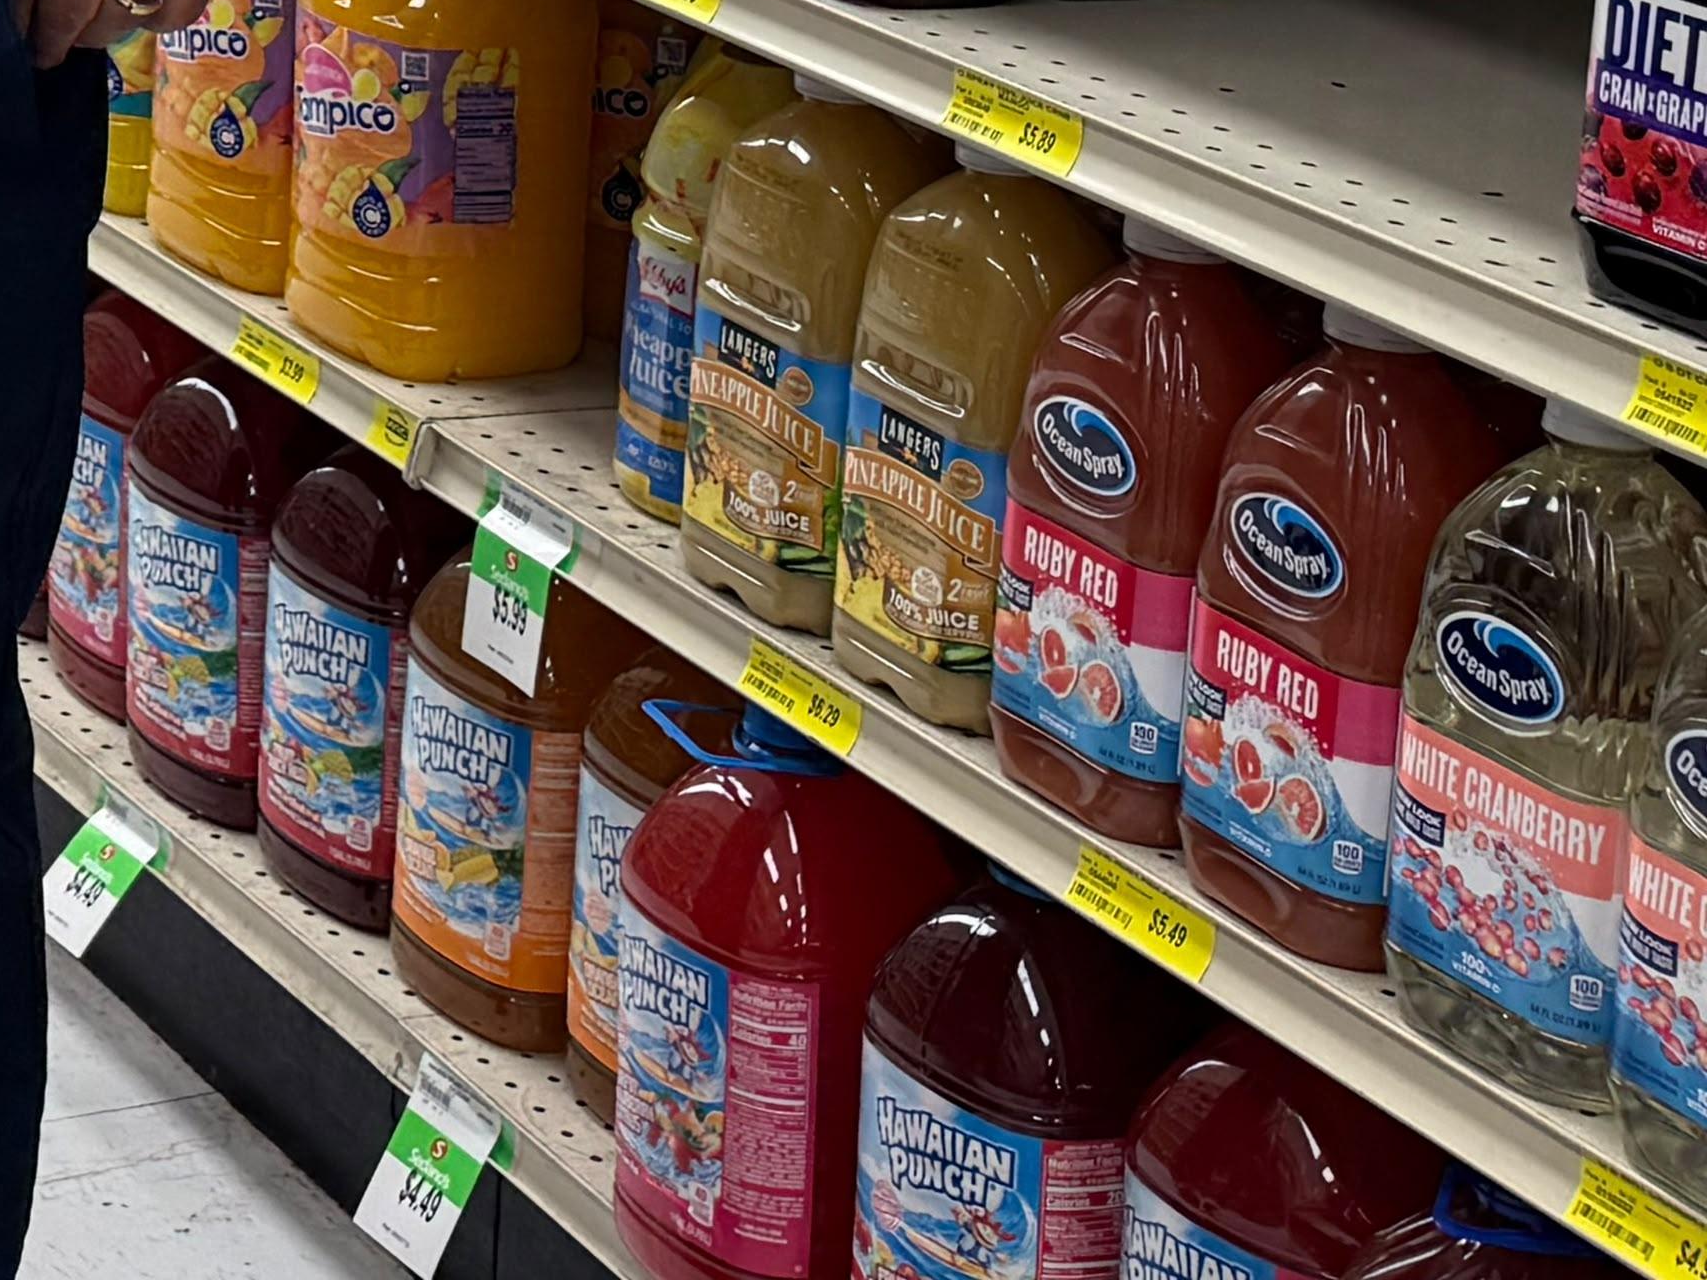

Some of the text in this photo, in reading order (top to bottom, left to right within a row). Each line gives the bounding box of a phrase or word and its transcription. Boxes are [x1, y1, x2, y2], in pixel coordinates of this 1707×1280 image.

[1600, 69, 1646, 117] CRAN
[1018, 119, 1057, 155] $5.89
[720, 323, 777, 379] LANGERS
[762, 392, 816, 459] JUICE
[880, 413, 941, 471] LANGERS
[1041, 412, 1125, 480] Ocean Spray
[760, 505, 811, 532] JUICE
[844, 452, 987, 555] PINEAPPLE JUICE
[141, 554, 199, 590] PUNCH
[1024, 524, 1119, 610] RUBY RED
[1240, 507, 1331, 581] Ocean Spray
[273, 602, 368, 666] HAWAIIAN
[491, 585, 529, 636] $5.99
[925, 605, 980, 633] JUICE
[280, 643, 350, 683] PUNCH
[1217, 631, 1320, 720] RUBY RED
[1447, 630, 1553, 705] Ocean Spray
[411, 696, 509, 764] HAWAIIAN
[806, 692, 842, 729] $6.29
[1132, 724, 1156, 742] 130
[417, 736, 488, 783] PUNCH
[1400, 731, 1608, 866] WHITE CRANBERRY
[1628, 850, 1695, 929] WHITE
[1147, 907, 1189, 948] $5.49
[1571, 977, 1599, 996] 100
[877, 1096, 1017, 1187] HAWAIIAN
[398, 1175, 443, 1223] $4.49
[890, 1146, 992, 1205] PUNCH
